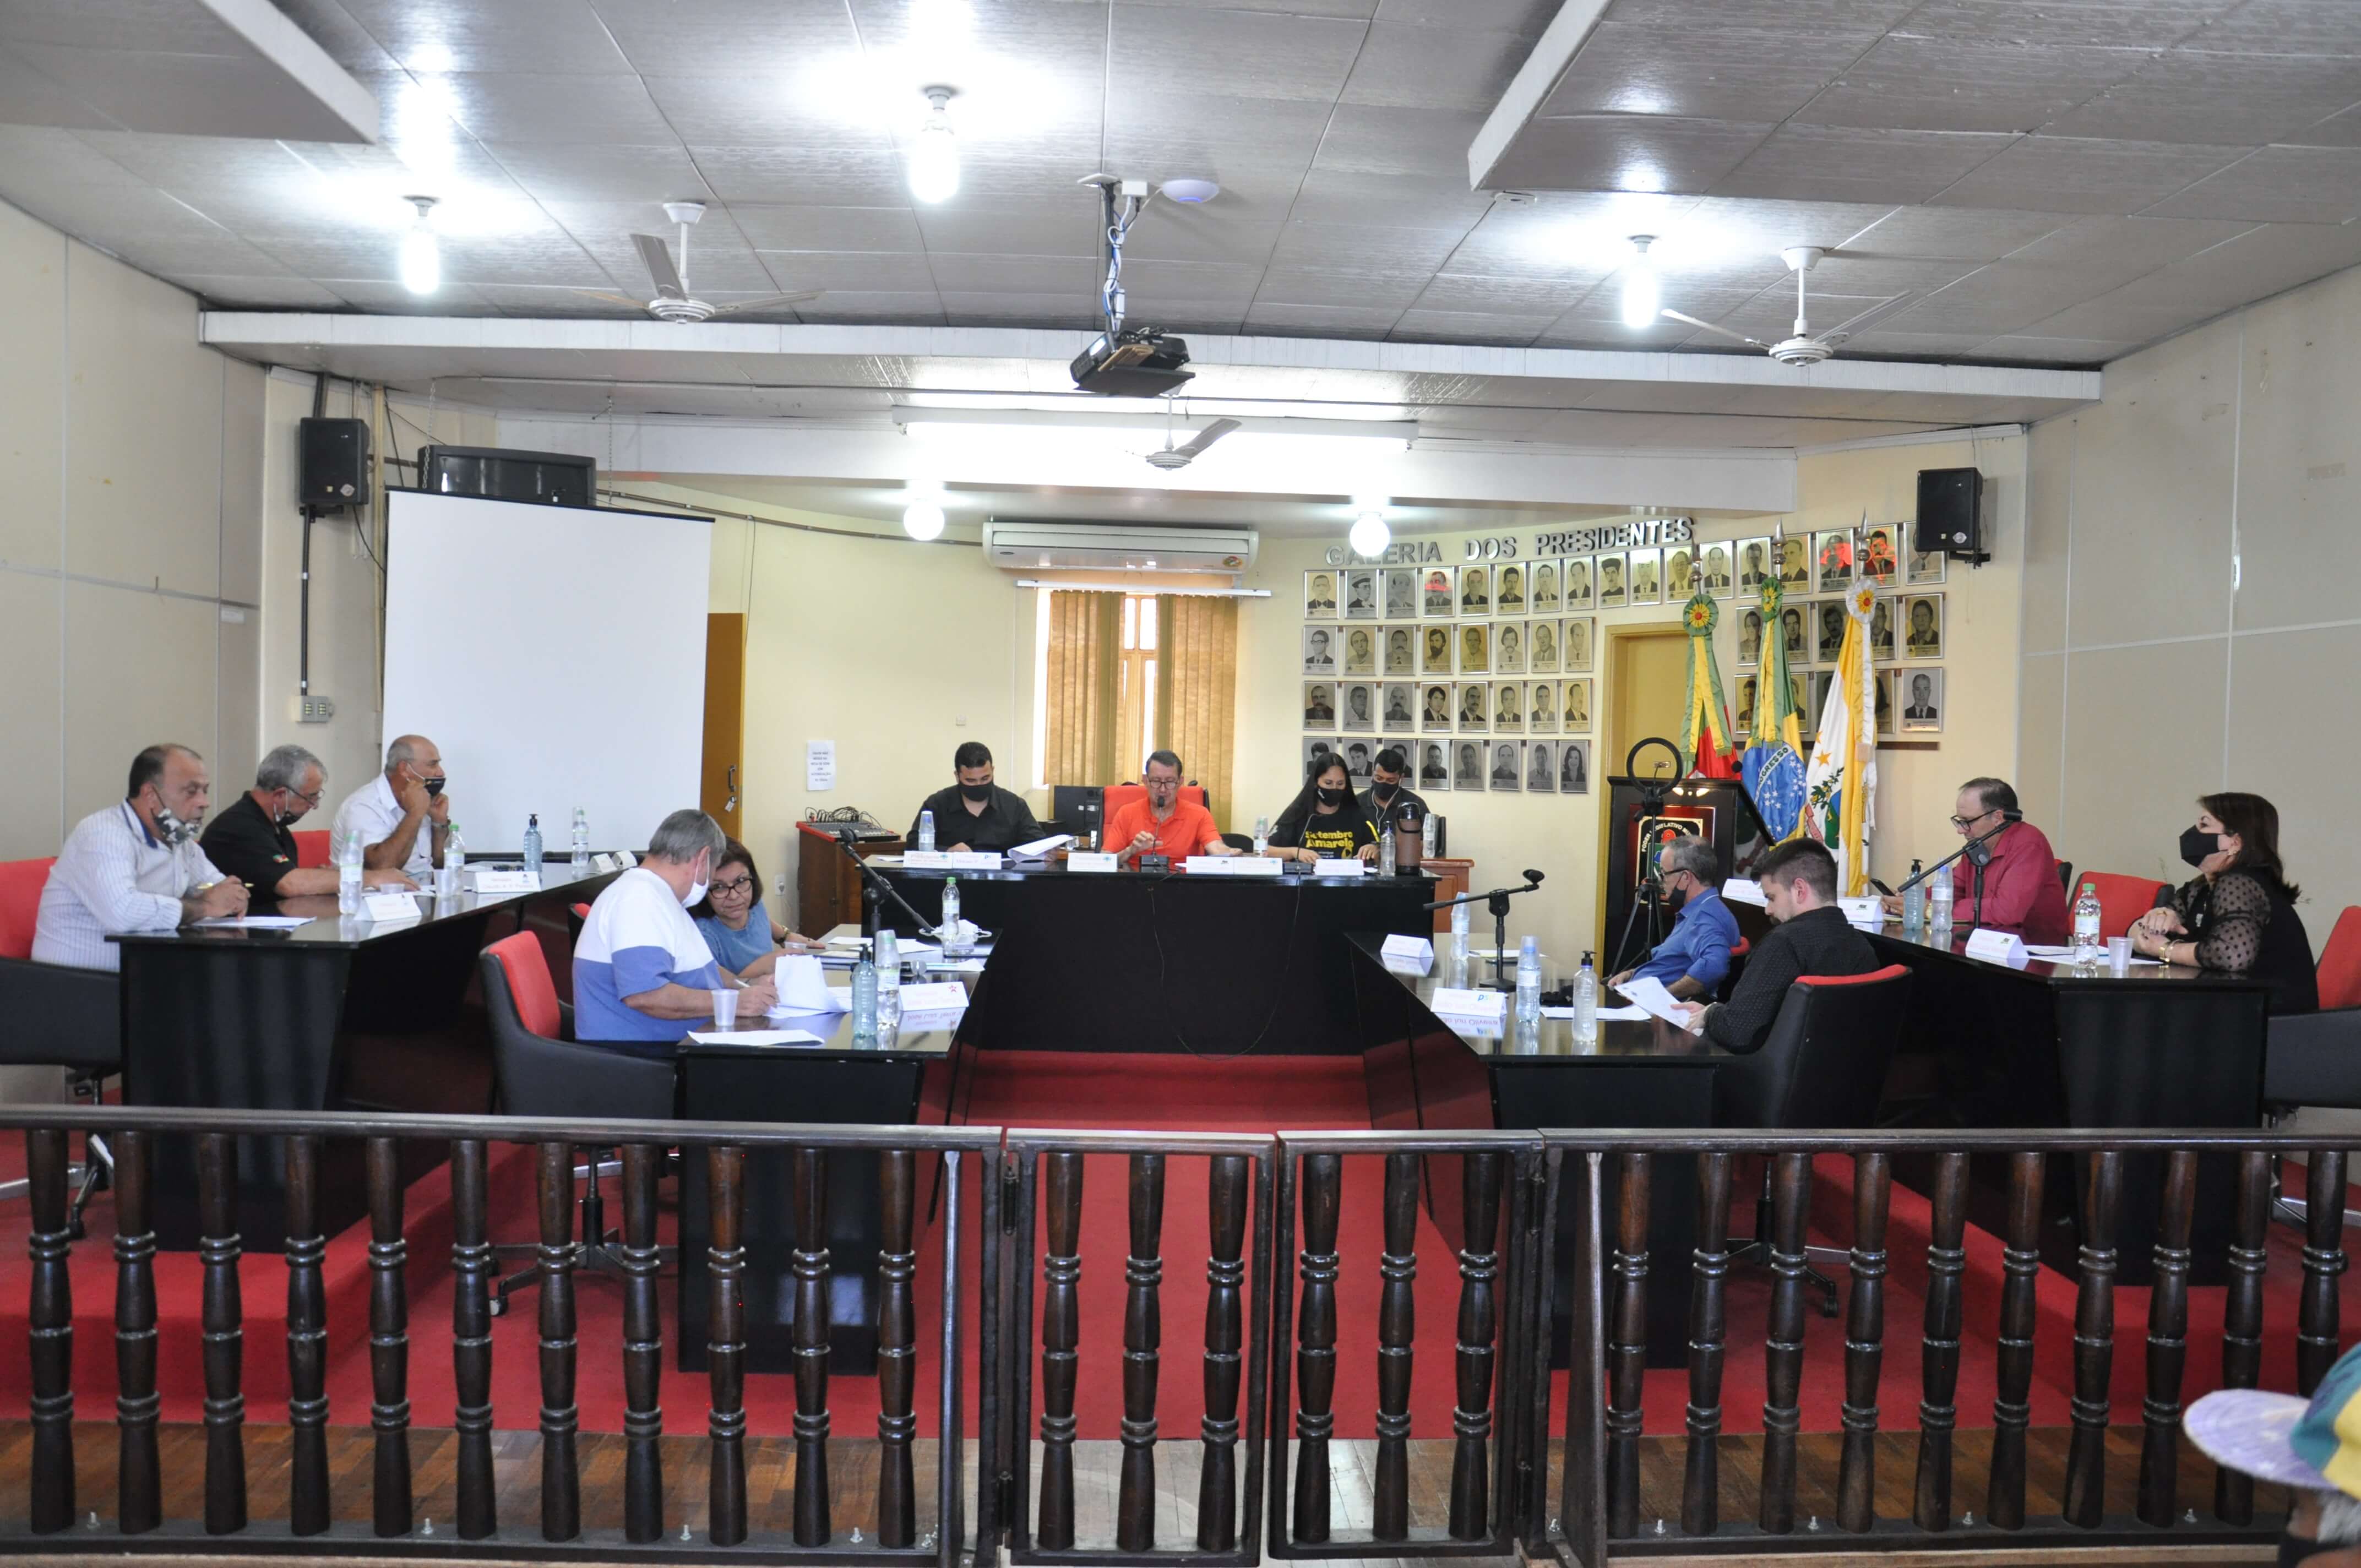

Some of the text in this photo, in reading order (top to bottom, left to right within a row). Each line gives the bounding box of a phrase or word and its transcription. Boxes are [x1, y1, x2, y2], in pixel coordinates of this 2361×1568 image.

[1465, 536, 1516, 560] DOS
[1535, 516, 1694, 555] PRESIDENTES
[1305, 837, 1354, 848] Amarelo
